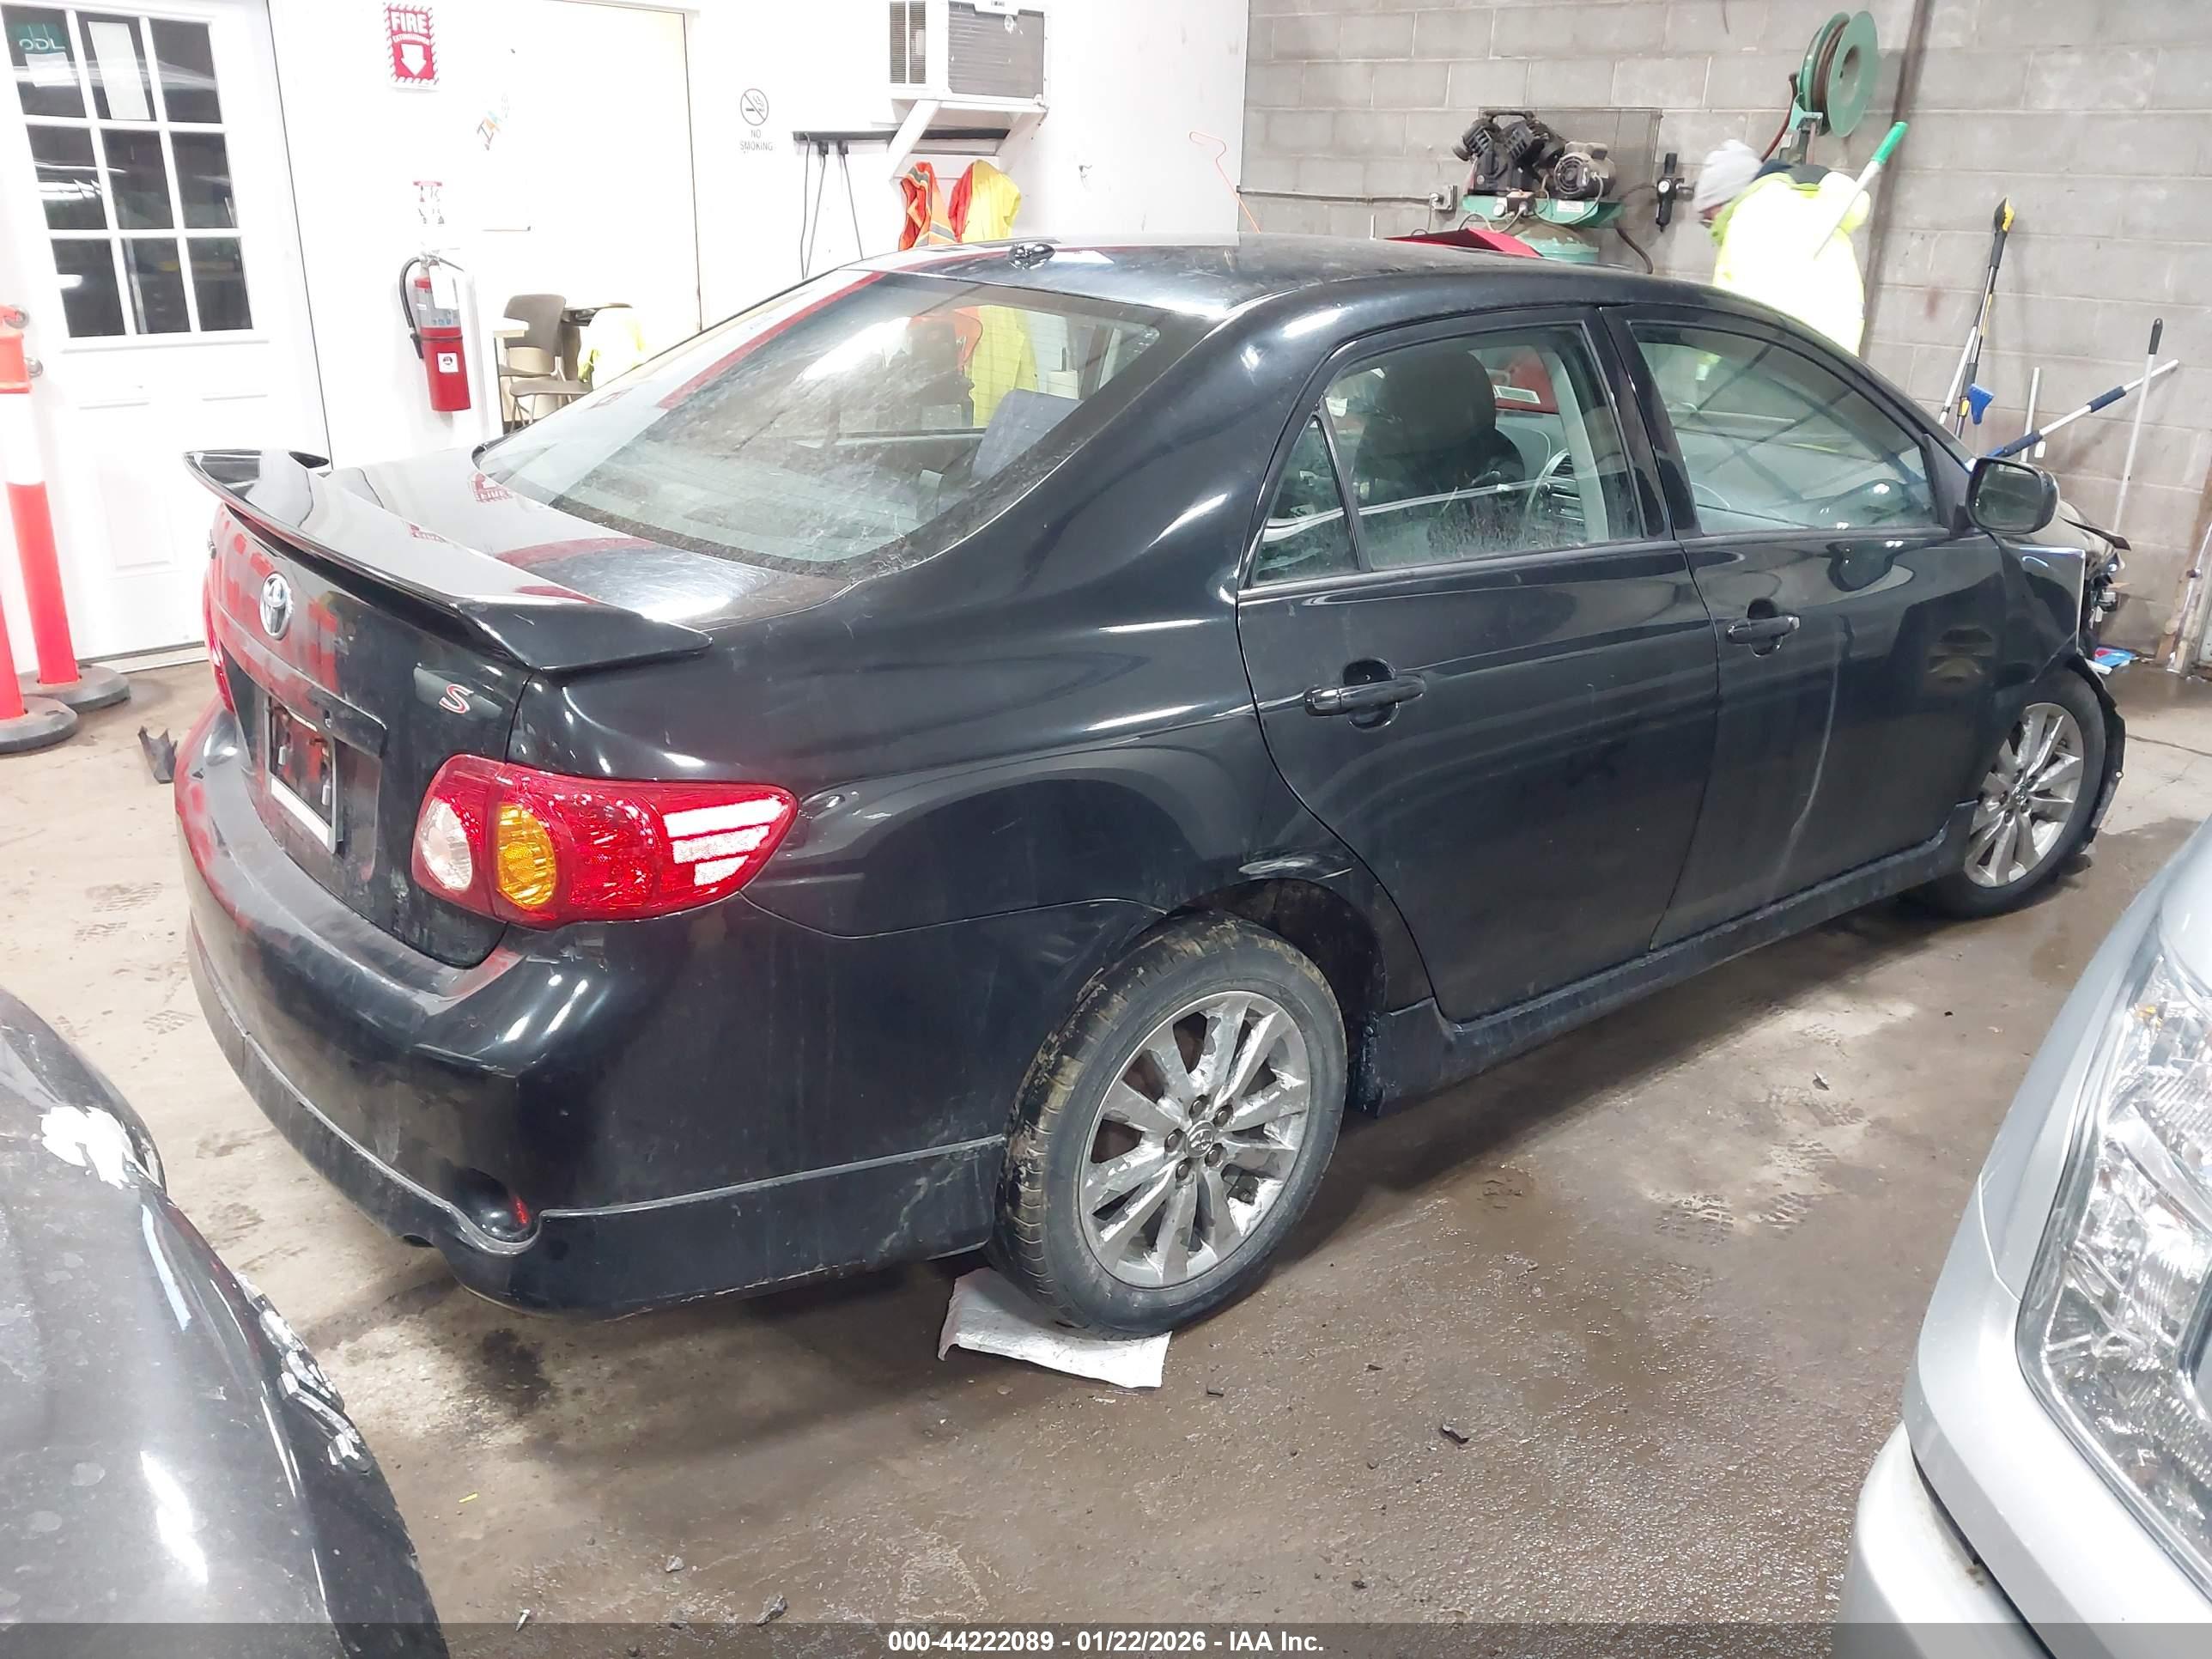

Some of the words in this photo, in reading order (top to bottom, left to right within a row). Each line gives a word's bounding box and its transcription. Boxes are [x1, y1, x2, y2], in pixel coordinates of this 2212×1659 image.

[391, 11, 429, 34] FIRE
[750, 129, 762, 138] NO
[739, 140, 774, 152] SMOKING
[439, 684, 474, 714] S
